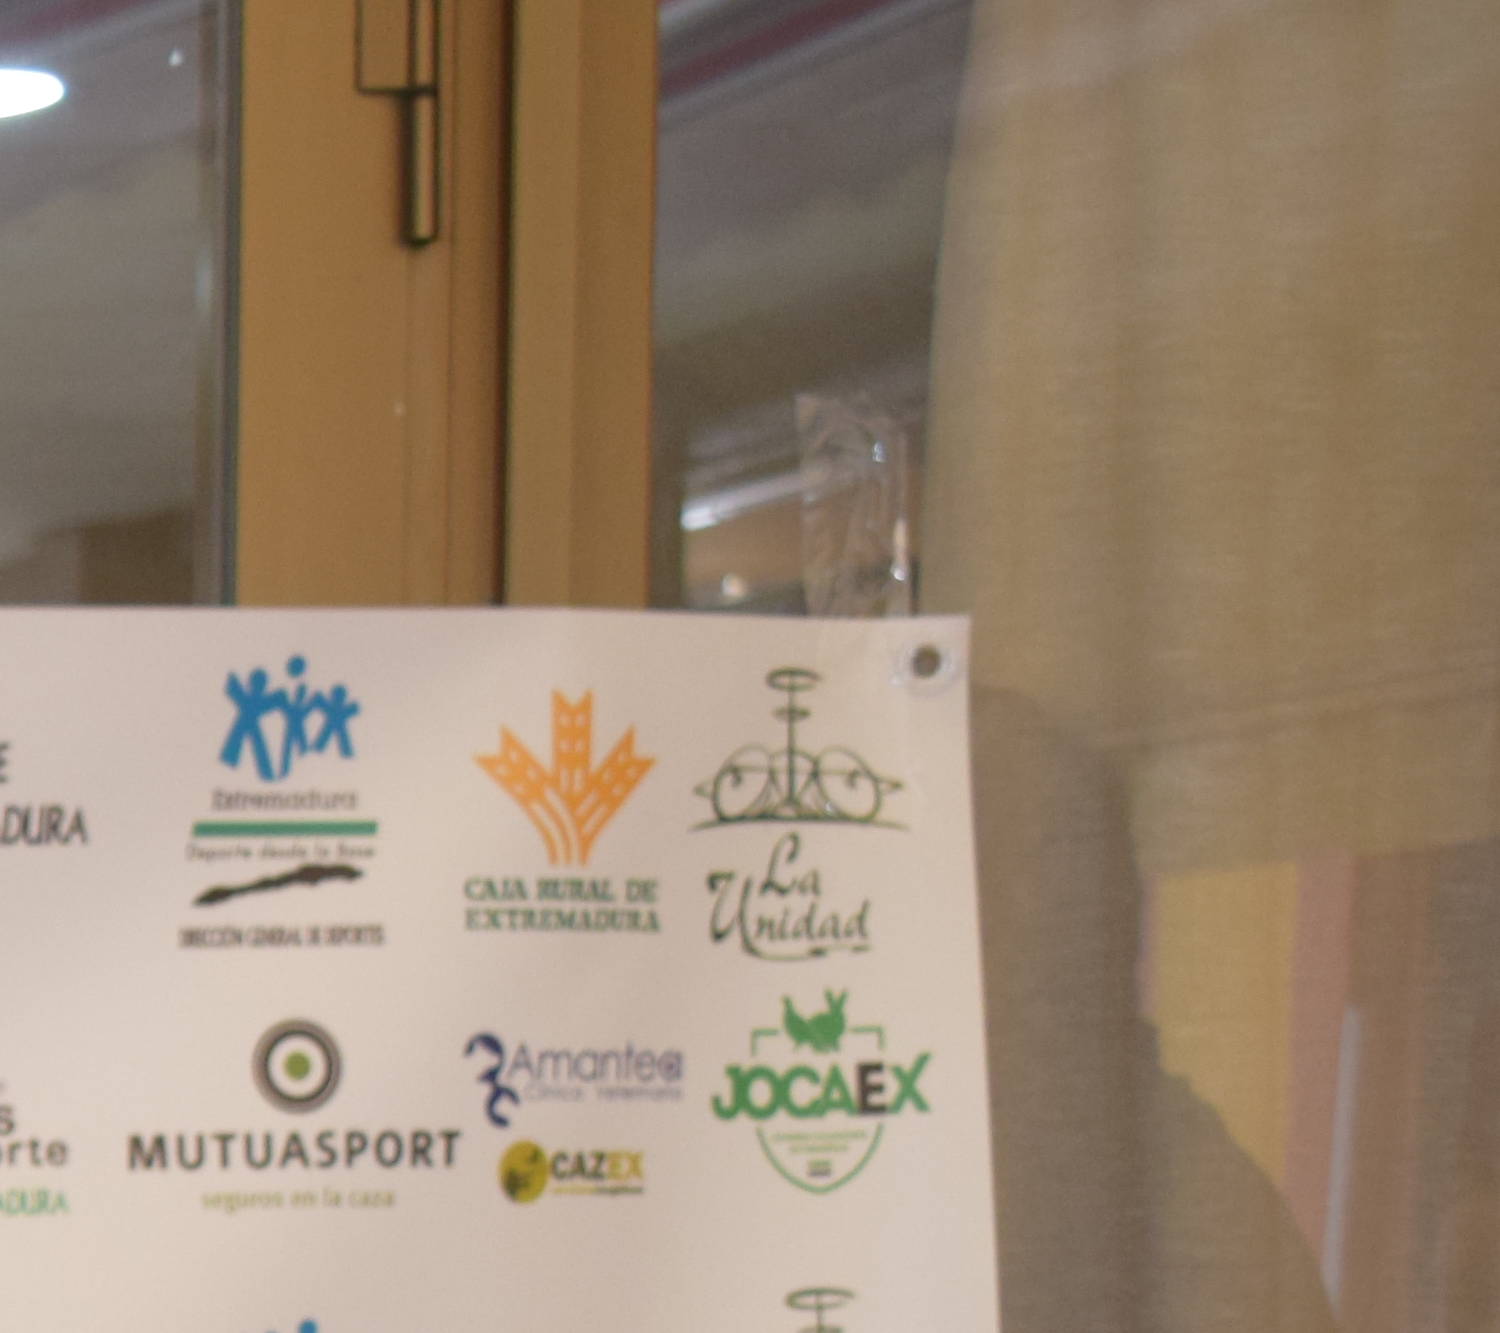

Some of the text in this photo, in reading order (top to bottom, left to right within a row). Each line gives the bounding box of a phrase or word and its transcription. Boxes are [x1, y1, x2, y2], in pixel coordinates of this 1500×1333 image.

[211, 788, 358, 811] Extremadura
[760, 831, 821, 897] La
[465, 877, 659, 902] CAJA RURAL DE
[466, 907, 662, 933] EXTREMADURA
[706, 869, 872, 962] Unidad
[711, 1052, 932, 1120] JOCAEX
[126, 1128, 463, 1173] MUTUASPORT
[550, 1149, 645, 1182] CAZEX
[201, 1186, 396, 1213] seguros en la caza
